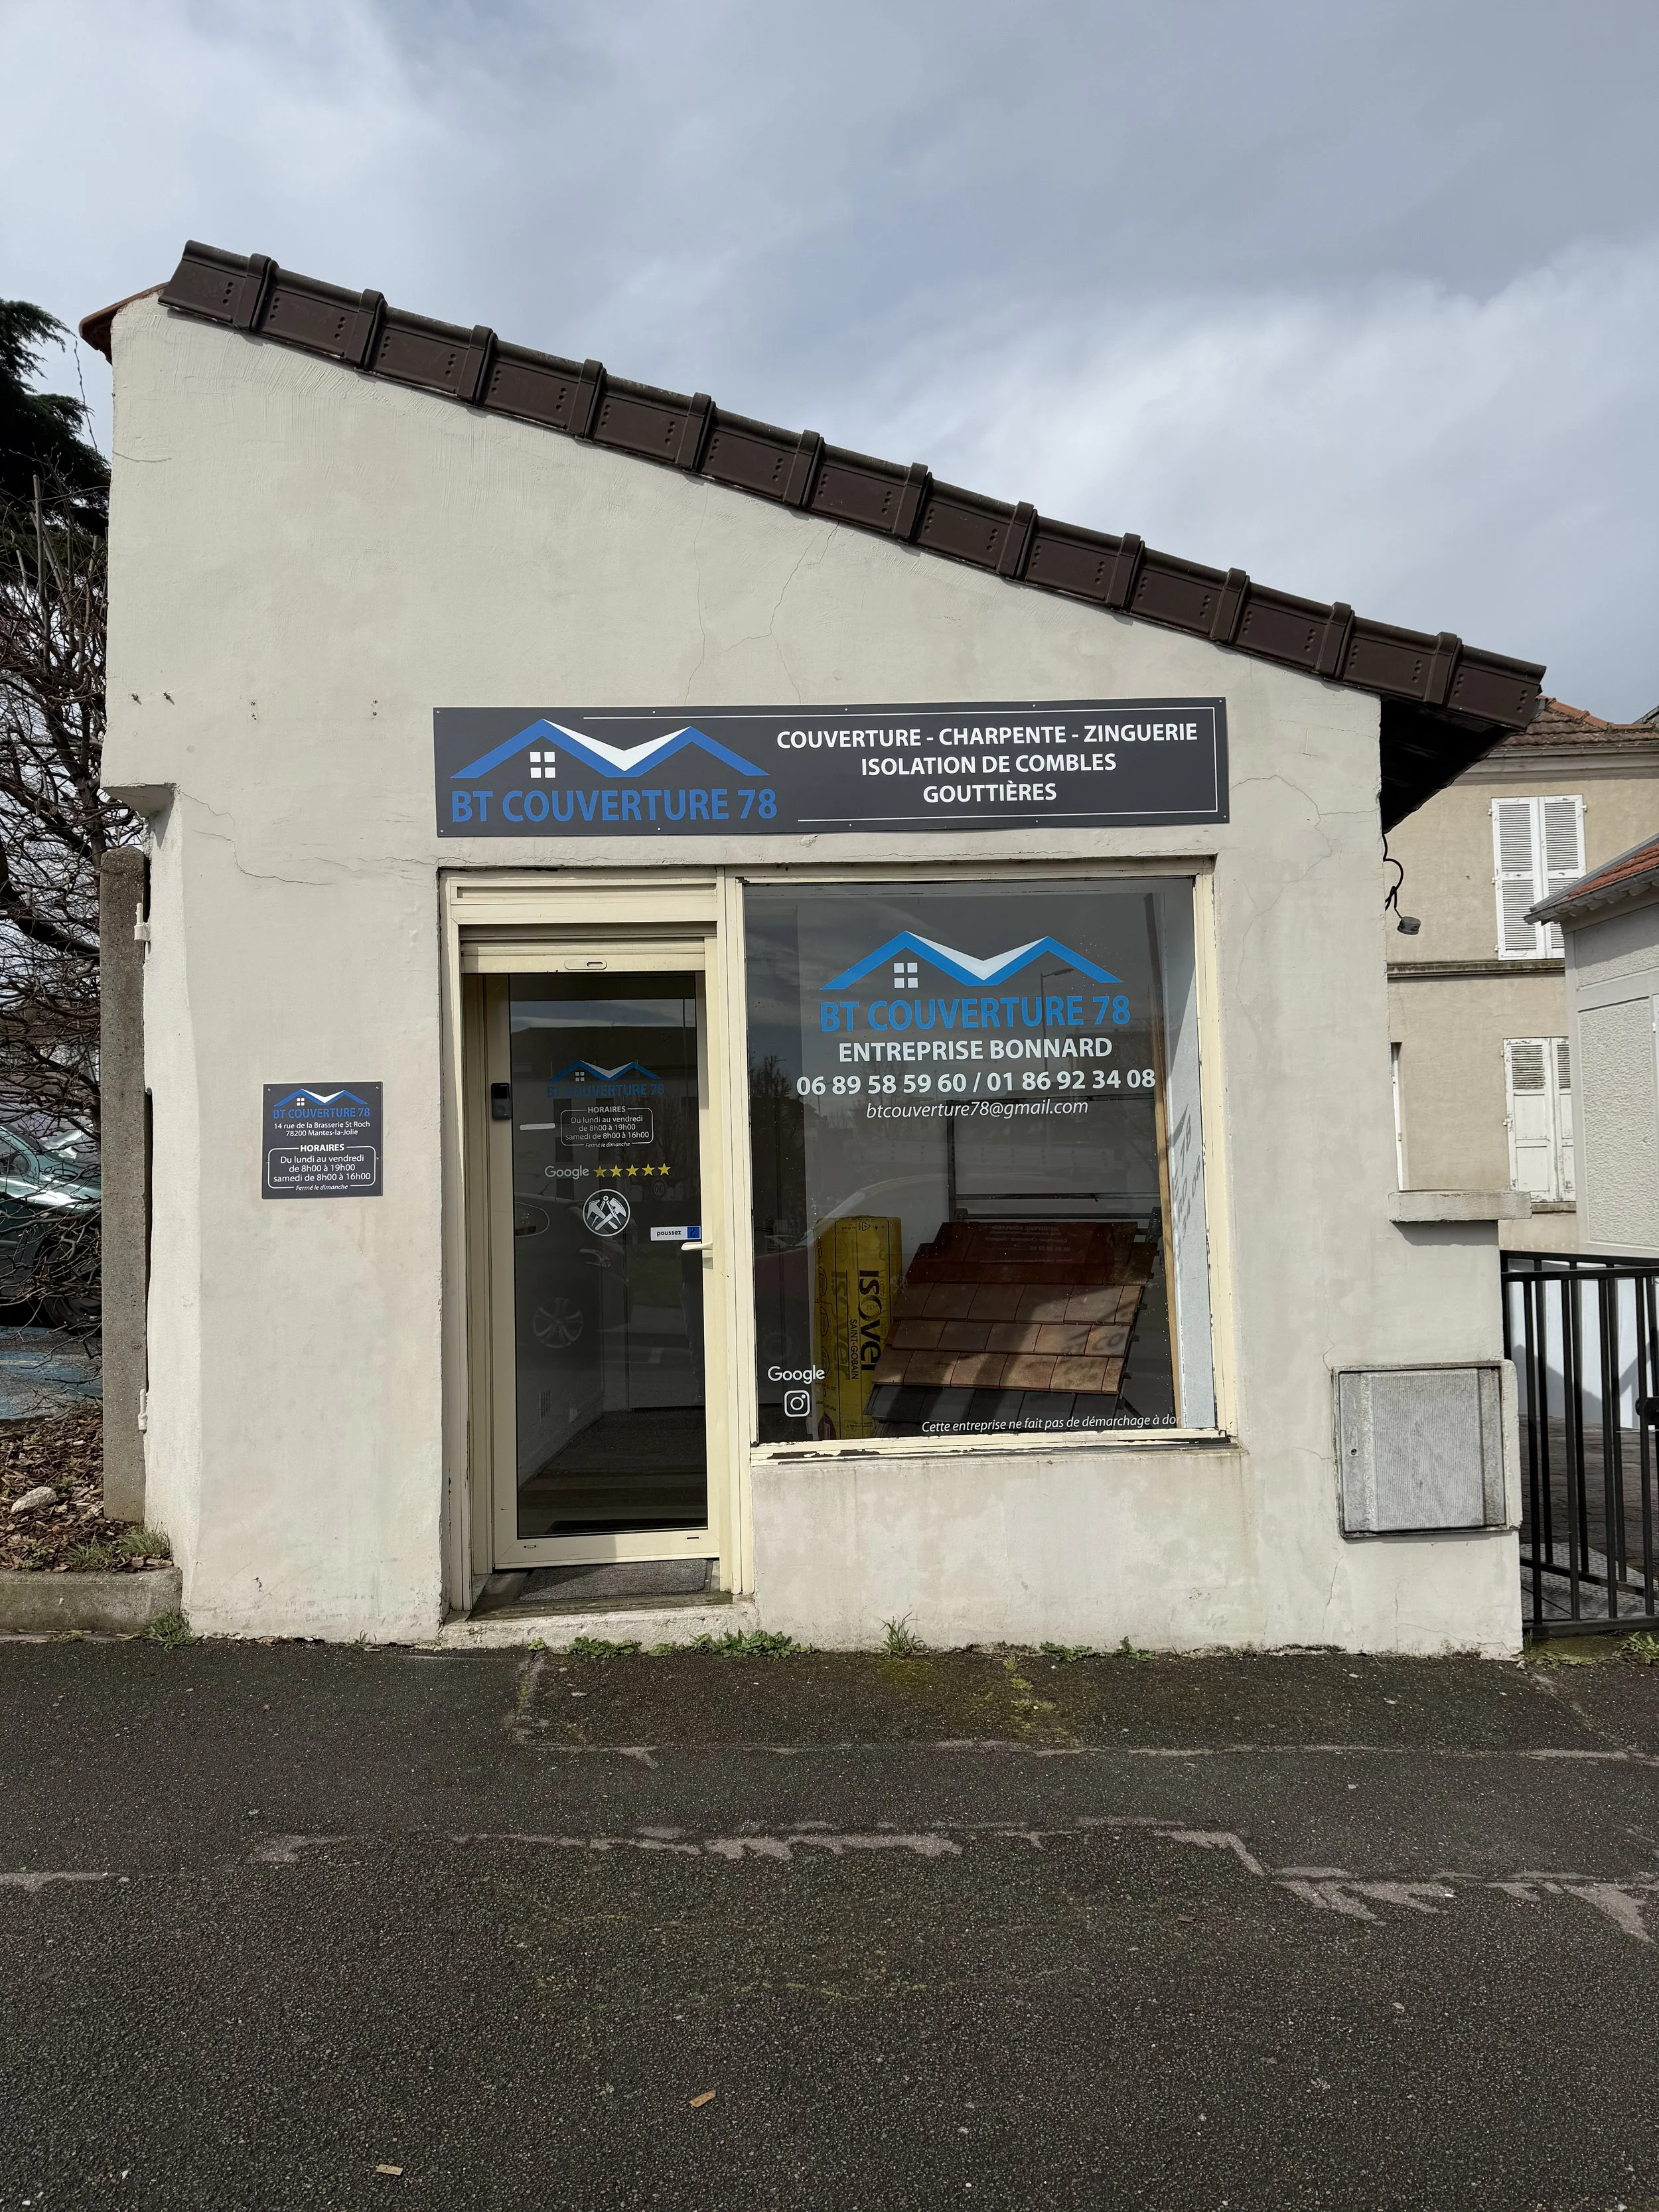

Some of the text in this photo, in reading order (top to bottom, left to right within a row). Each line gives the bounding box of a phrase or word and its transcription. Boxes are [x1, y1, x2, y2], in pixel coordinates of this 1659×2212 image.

[776, 729, 921, 749] COUVERTURE
[939, 725, 1066, 745] CHARPENTE
[1084, 723, 1197, 742] ZINGUERIE
[861, 753, 1117, 776] ISOLATION DE COMBLES
[922, 780, 1057, 803] GOUTTIÈRES
[452, 788, 778, 822] BT COUVERTURE 78
[820, 995, 1131, 1032] BT COUVERTURE 78
[839, 1037, 1113, 1062] ENTREPRISE BONNARD
[797, 1076, 826, 1096] 06
[833, 1075, 861, 1094] 89
[869, 1074, 897, 1094] 58
[904, 1074, 931, 1093] 59
[938, 1073, 966, 1092] 60
[987, 1072, 1013, 1091] 01
[1023, 1071, 1050, 1090] 86
[1058, 1070, 1085, 1090] 92
[1093, 1070, 1121, 1088] 34
[1127, 1069, 1156, 1088] 08
[273, 1108, 370, 1119] BT COUVERTURE 78
[866, 1098, 1088, 1120] btcouverture78@gmail.com
[545, 1165, 589, 1179] Google
[850, 1319, 859, 1380] SAINT-GOBAIN
[768, 1365, 825, 1384] Google
[922, 1421, 951, 1432] Cette
[952, 1418, 1007, 1433] entreprise
[1009, 1420, 1023, 1429] ne
[1024, 1417, 1043, 1431] fait
[1045, 1419, 1064, 1430] pas
[1066, 1416, 1080, 1427] de
[1082, 1414, 1150, 1429] démarchage
[1153, 1414, 1160, 1425] à
